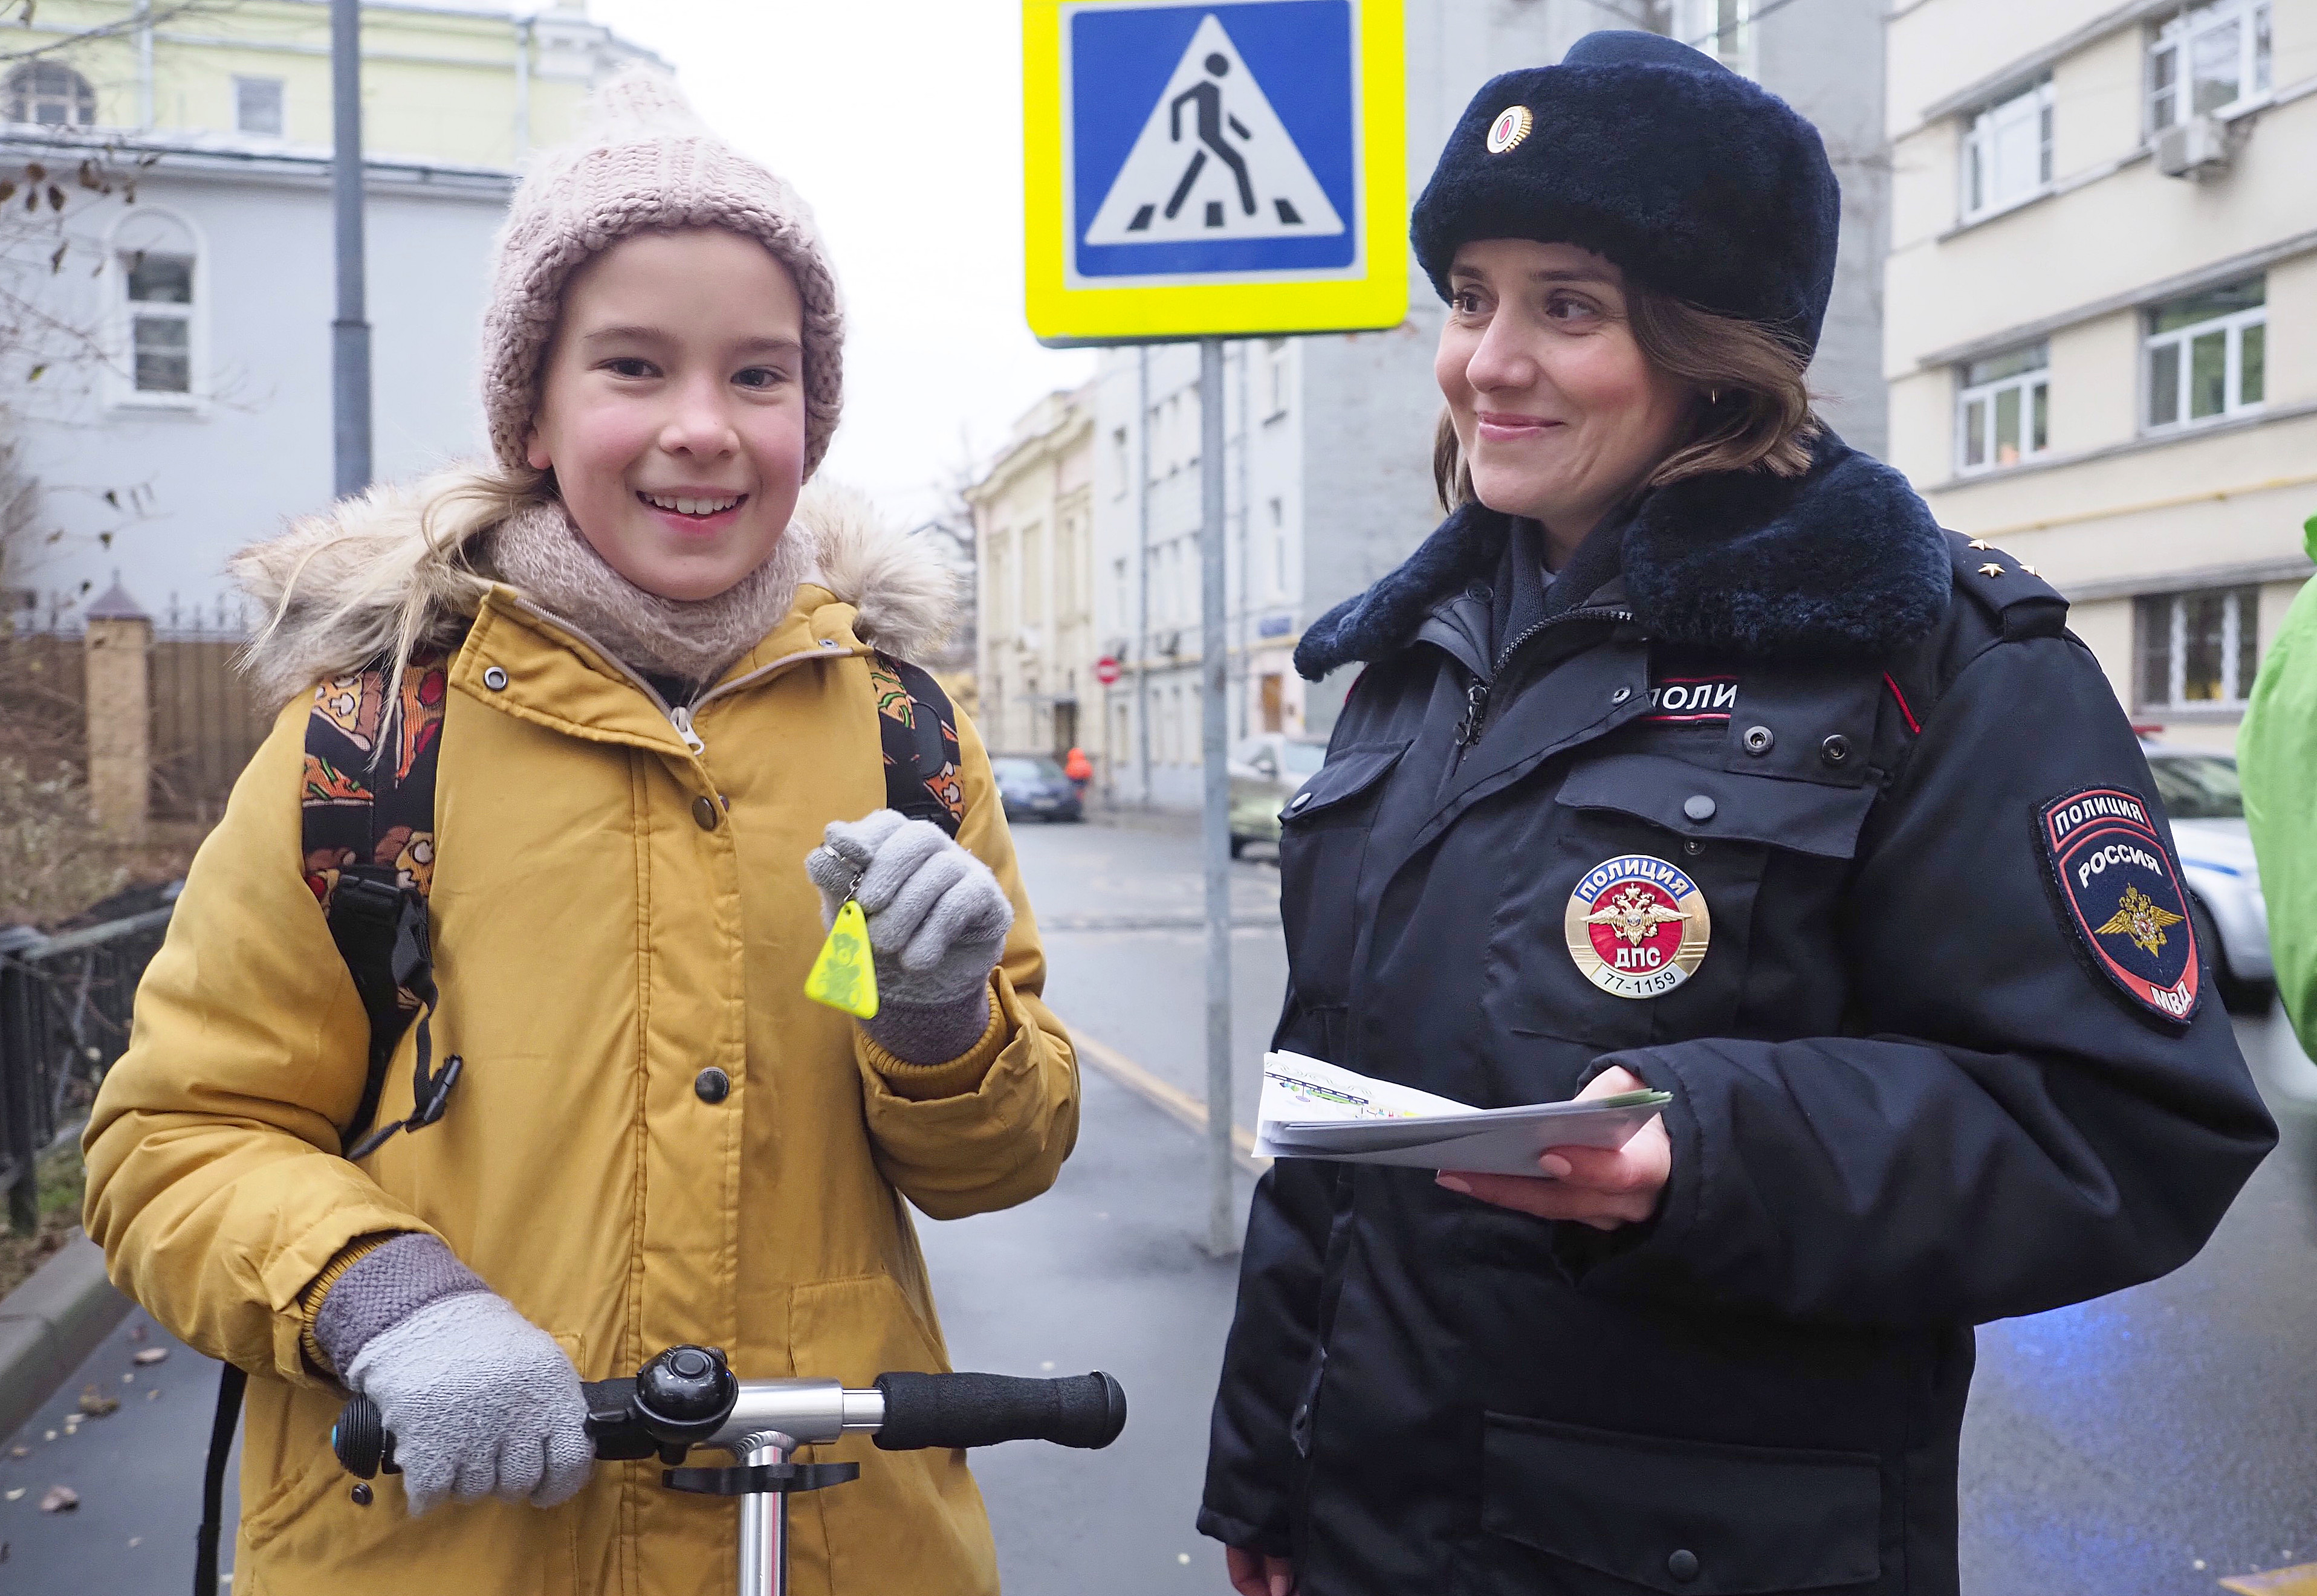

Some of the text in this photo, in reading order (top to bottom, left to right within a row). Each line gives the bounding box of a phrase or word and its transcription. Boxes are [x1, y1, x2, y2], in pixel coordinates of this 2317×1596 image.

[2055, 797, 2145, 836] ПОЛИЦИЯ
[1580, 859, 1690, 900] ПОЛИЦИЯ
[2078, 844, 2163, 889] РОССИЯ
[1615, 947, 1661, 968] ДПС
[1604, 972, 1676, 993] 77-1159
[2150, 980, 2192, 1015] МВД
